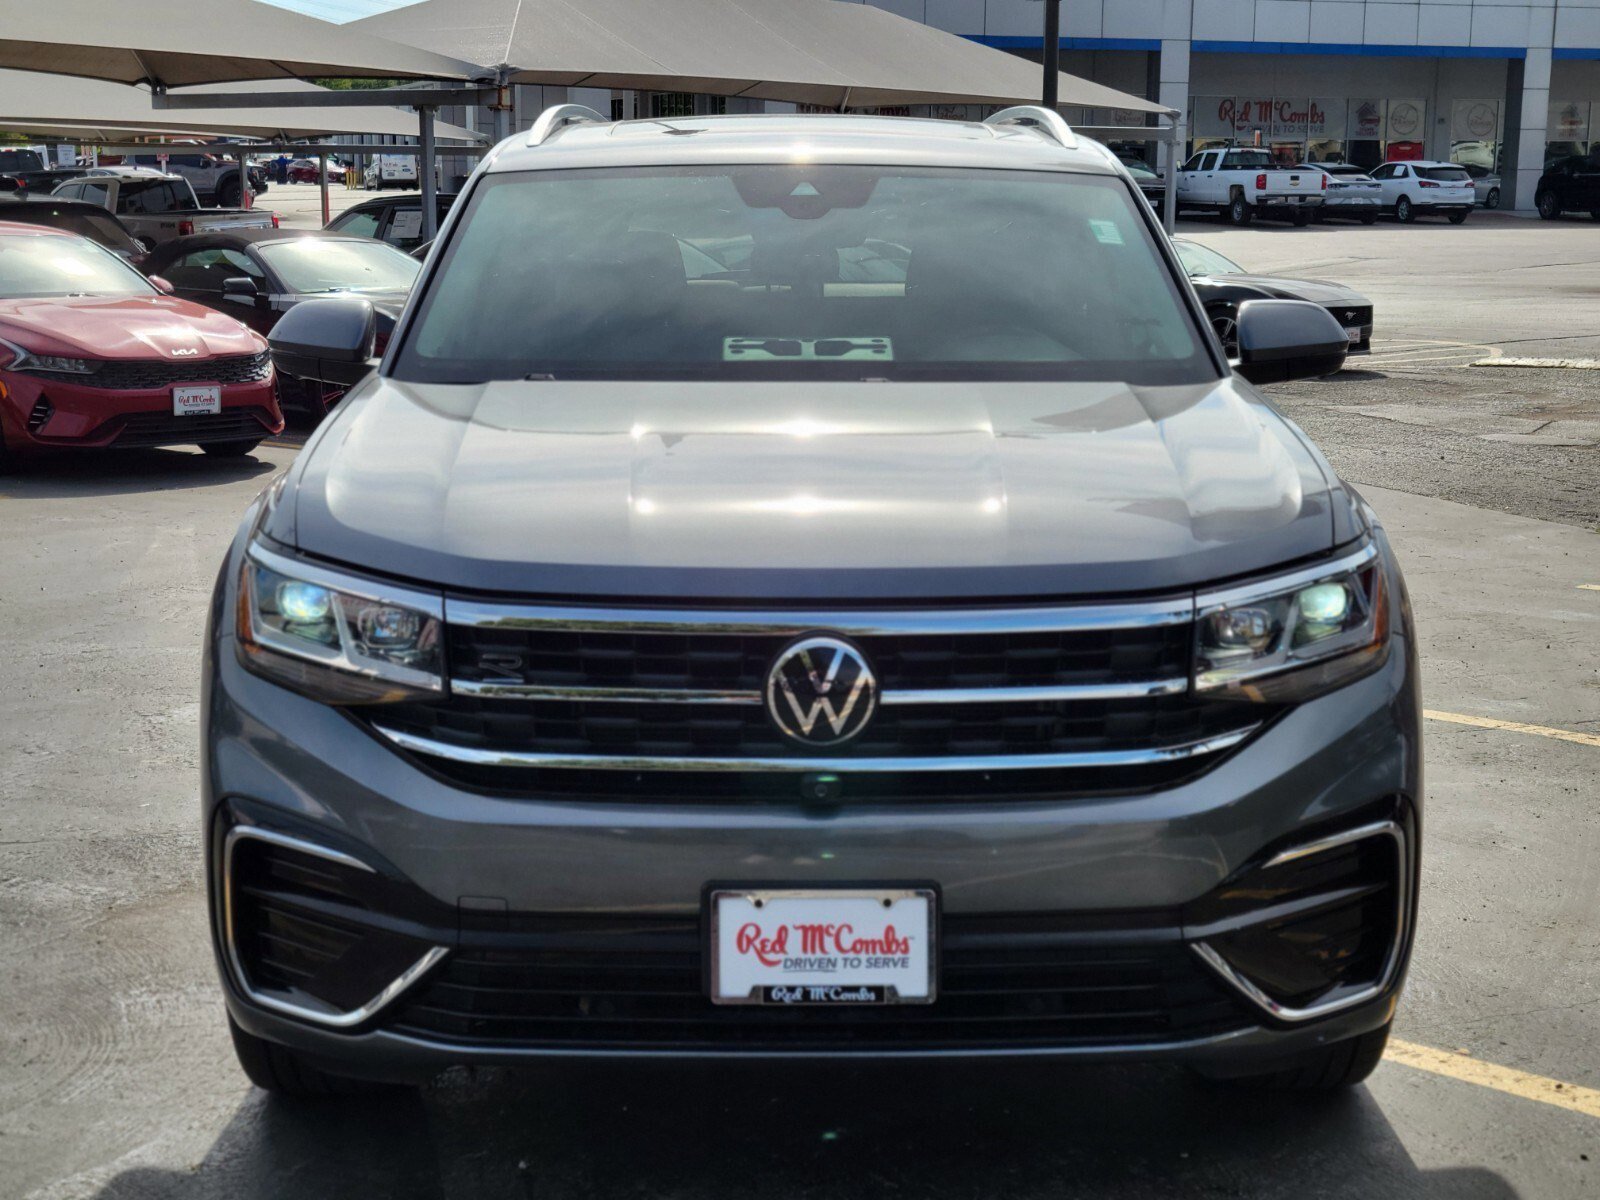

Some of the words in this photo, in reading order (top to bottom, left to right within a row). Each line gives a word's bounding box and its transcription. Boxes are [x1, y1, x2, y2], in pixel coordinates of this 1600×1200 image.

[1283, 124, 1295, 133] TO
[736, 923, 788, 967] Red
[793, 923, 910, 955] McCombs
[783, 957, 837, 970] DRIVEN
[842, 957, 861, 969] TO
[866, 957, 910, 969] SERVE
[771, 986, 801, 1003] Red
